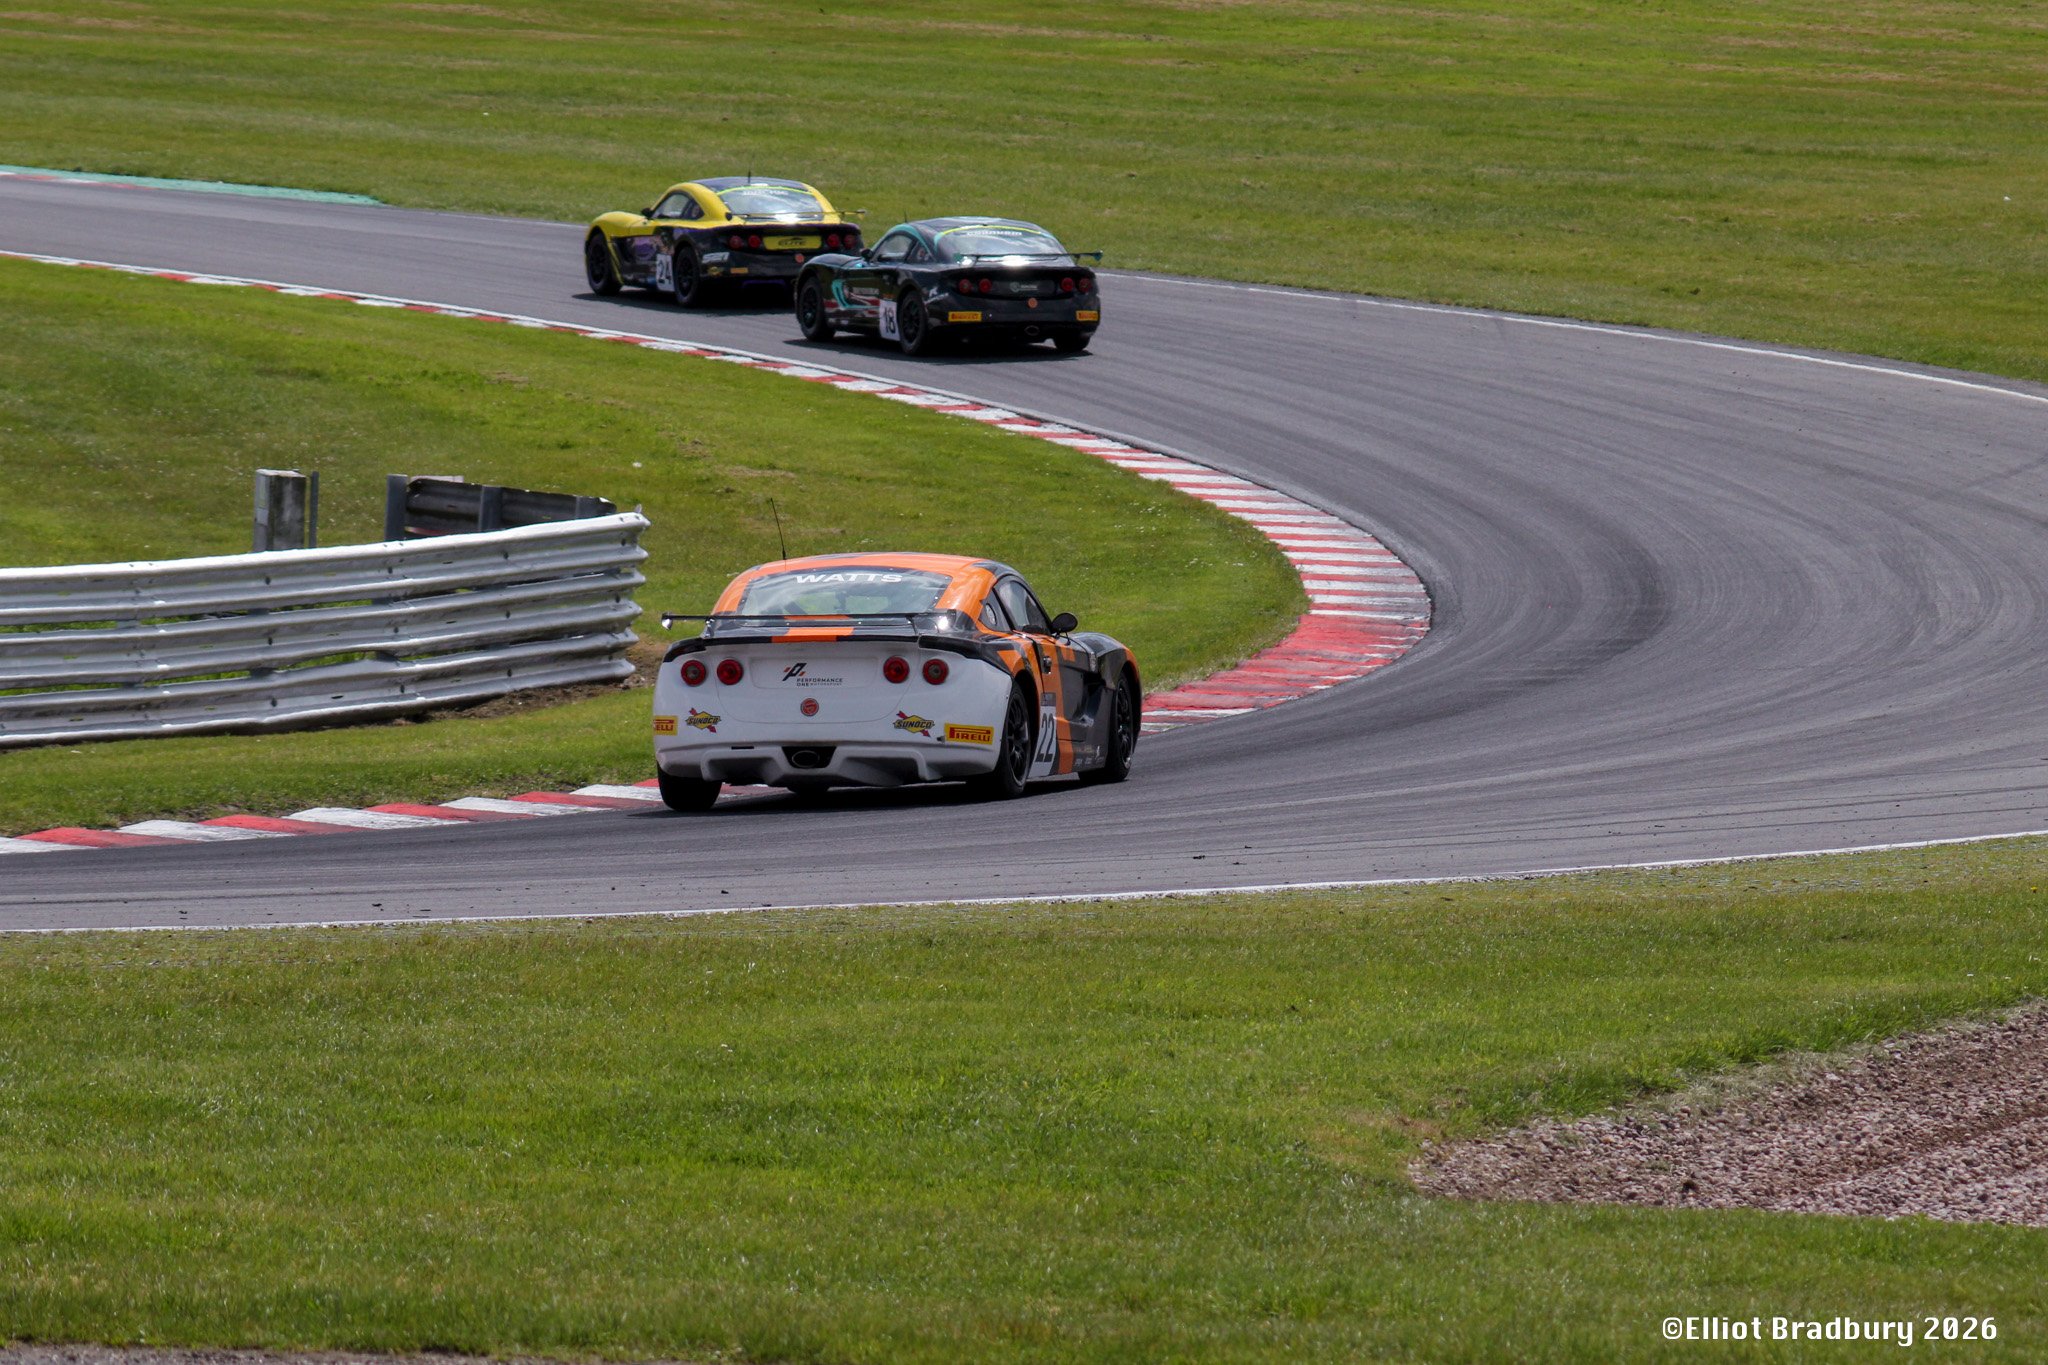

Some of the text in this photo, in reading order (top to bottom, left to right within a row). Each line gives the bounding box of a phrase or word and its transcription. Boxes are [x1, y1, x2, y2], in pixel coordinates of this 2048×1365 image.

[797, 573, 902, 583] WATTS
[688, 717, 719, 725] SUNOCO
[896, 719, 933, 729] SUNOCO
[948, 726, 991, 742] PIRELLI
[1035, 712, 1055, 763] 22
